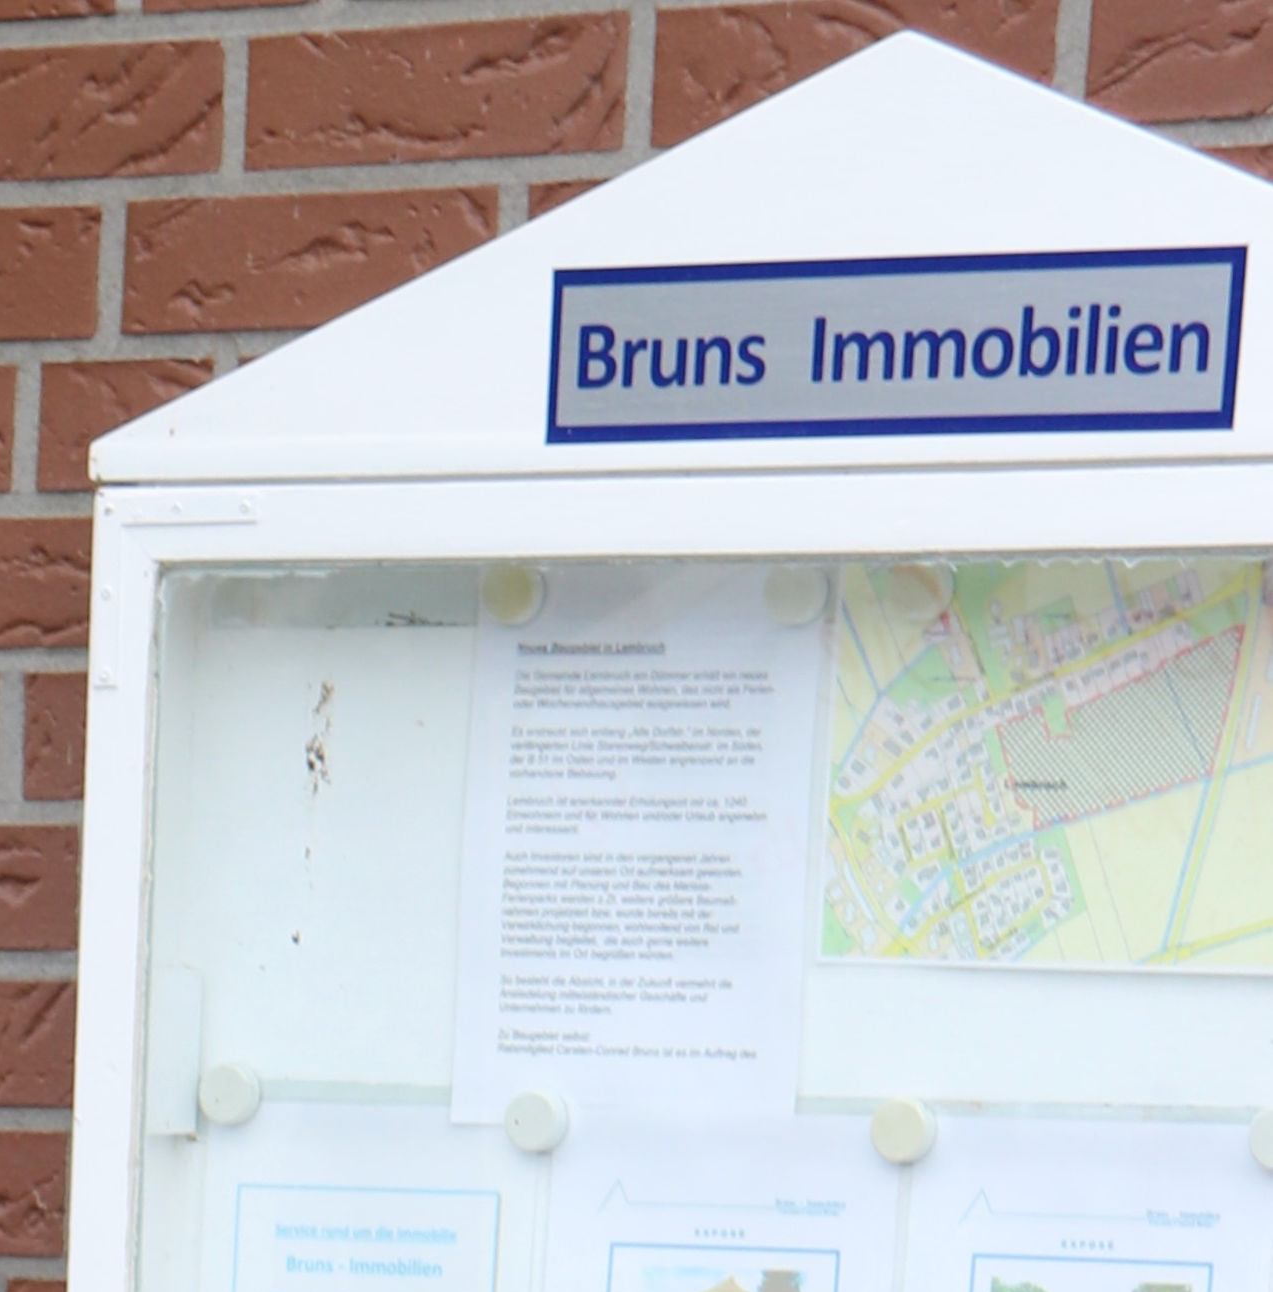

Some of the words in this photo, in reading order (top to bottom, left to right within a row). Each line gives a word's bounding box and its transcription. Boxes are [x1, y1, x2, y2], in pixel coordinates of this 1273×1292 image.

[575, 325, 766, 390] Bruns
[810, 304, 1211, 383] Immobilien
[286, 1255, 333, 1275] Bruns
[349, 1257, 443, 1278] Immobilien
